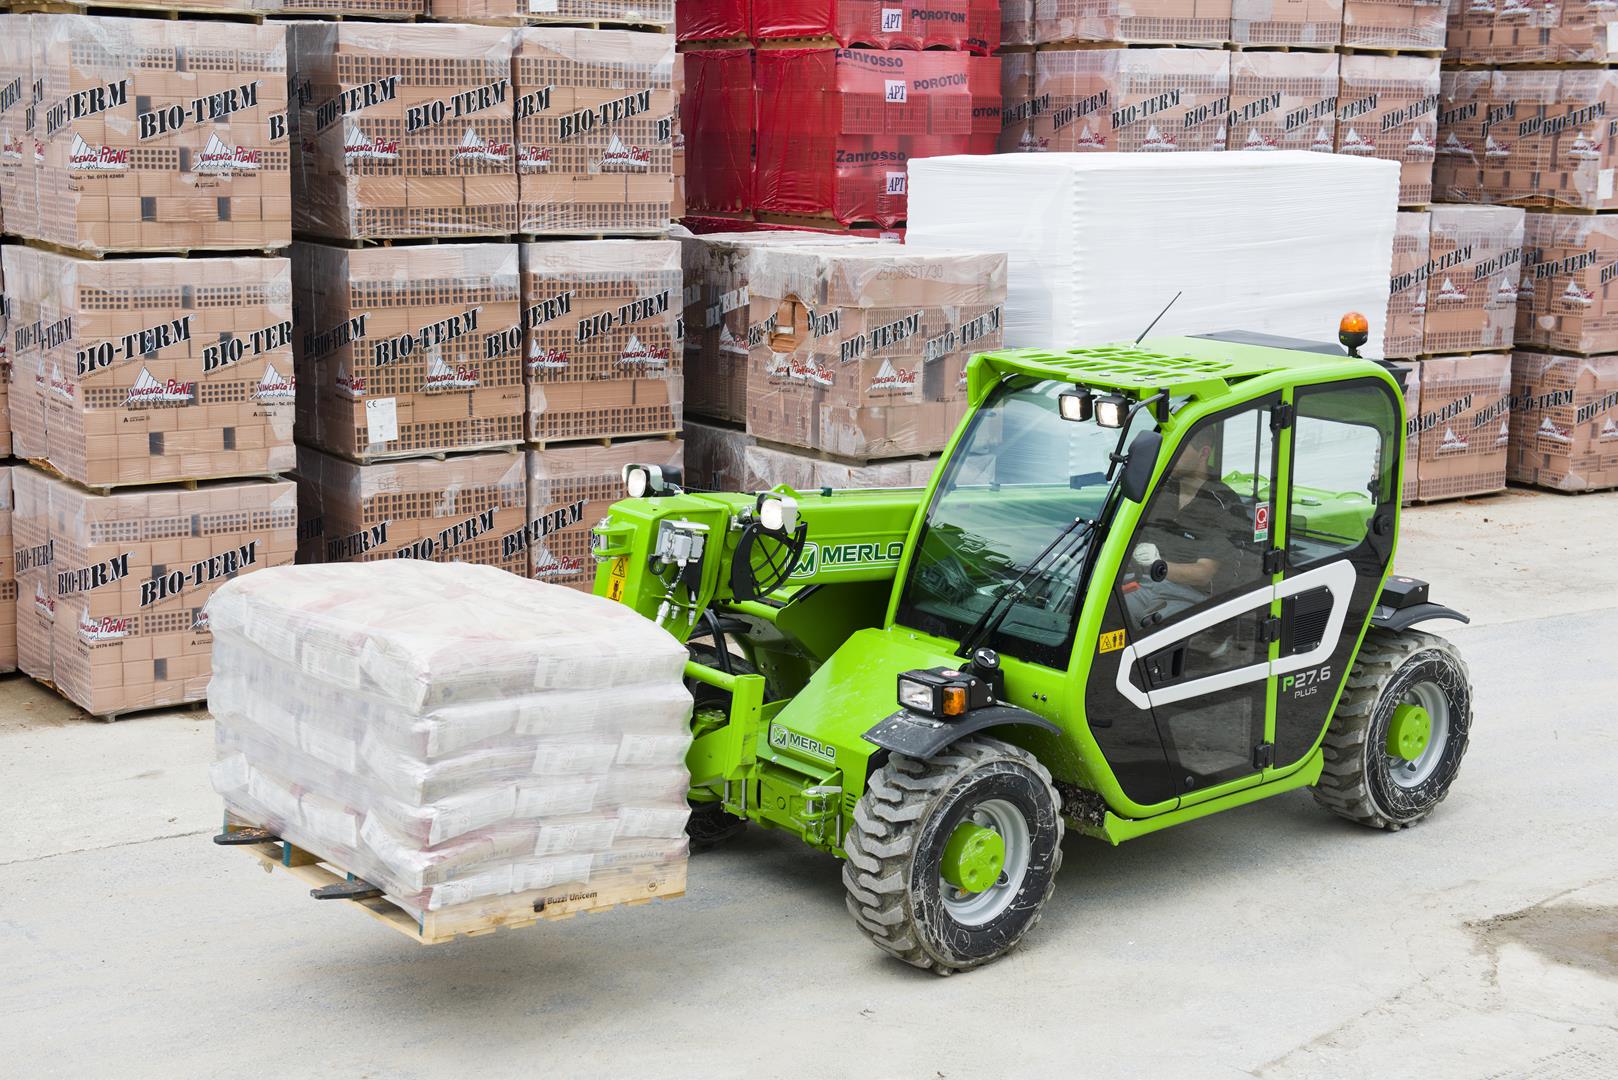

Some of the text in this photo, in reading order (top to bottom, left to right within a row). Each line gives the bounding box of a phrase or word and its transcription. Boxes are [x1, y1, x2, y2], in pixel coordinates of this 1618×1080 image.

[884, 13, 902, 29] APT
[912, 9, 966, 22] POROTON
[887, 85, 905, 100] APT
[914, 73, 967, 90] POROTON
[46, 80, 127, 134] BIO-TERM
[140, 81, 258, 139] BIO-TERM
[316, 77, 397, 131] BIO-TERM
[407, 80, 506, 132] BIO-TERM
[559, 90, 651, 139] BIO-TERM
[1053, 90, 1108, 130] BIO-TERM
[1112, 89, 1180, 130] BIO-TERM
[1543, 101, 1605, 135] BIO-TERM
[836, 150, 906, 163] Zanrosso
[888, 177, 905, 192] APT
[1536, 249, 1597, 279] BIO-TERM
[577, 290, 670, 342] BIO-TERM
[925, 306, 1000, 362] BIO-TERM
[76, 315, 191, 376] BIO-TERM
[376, 308, 478, 367] BIO-TERM
[840, 313, 919, 363] BIO-TERM
[821, 542, 904, 564] MERLO
[57, 553, 128, 594] BIO-TERM
[140, 541, 256, 607] BIO-TERM
[1283, 665, 1332, 692] P27.6
[1295, 686, 1318, 699] PLUS
[790, 732, 836, 758] MERLO
[569, 891, 597, 901] Unicem
